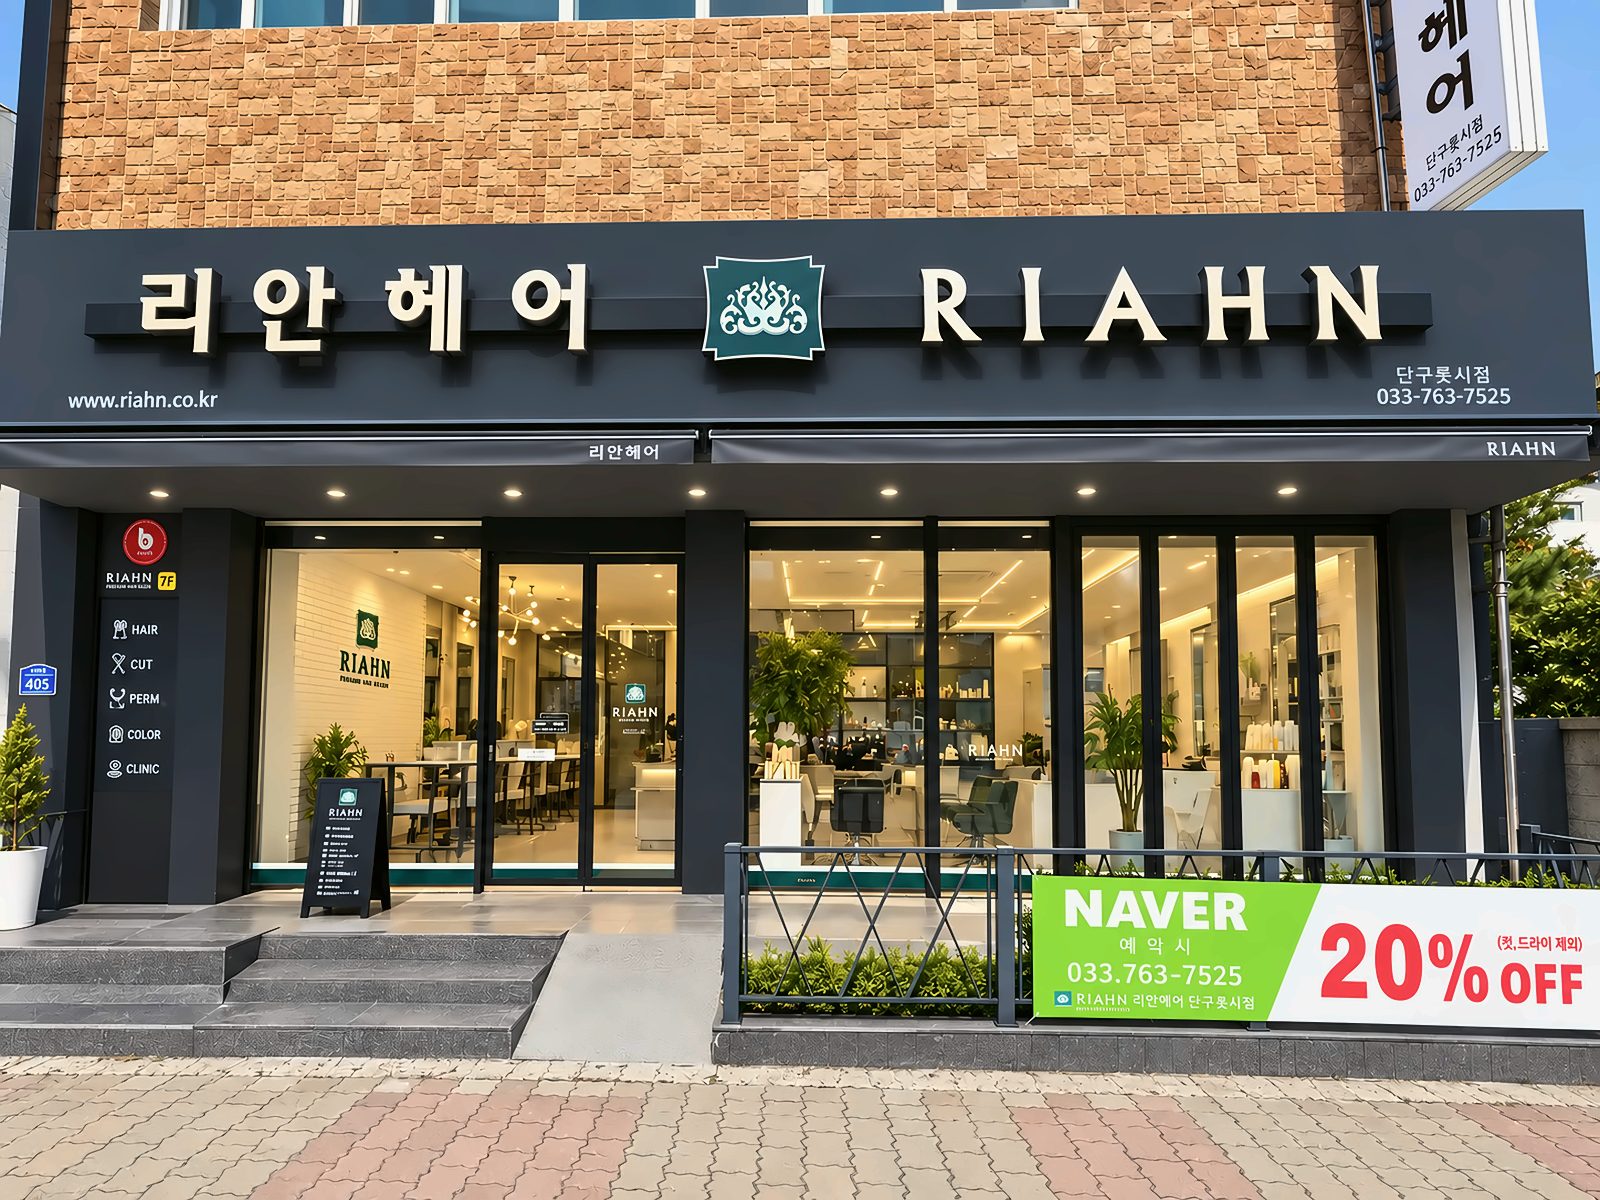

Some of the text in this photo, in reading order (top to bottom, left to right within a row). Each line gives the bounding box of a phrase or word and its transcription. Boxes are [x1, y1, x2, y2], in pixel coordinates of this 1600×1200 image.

[1414, 125, 1502, 202] 033-763-7525
[140, 263, 588, 355] 리안헤어
[920, 265, 1382, 345] RIAHN
[1396, 366, 1490, 384] 단구롯시점
[68, 390, 219, 408] www.riahn.co.kr
[1377, 388, 1511, 405] 033-763-7525
[589, 444, 659, 460] 리안헤어
[1487, 441, 1556, 456] RIAHN
[106, 572, 152, 583] RIAHN
[160, 576, 174, 587] 7F
[131, 624, 158, 635] HAIR
[130, 659, 153, 670] CUT
[339, 649, 391, 679] RIAHN
[25, 678, 49, 690] 405
[129, 693, 160, 704] PERM
[612, 707, 658, 718] RIAHN
[127, 729, 161, 740] COLOR
[968, 744, 1023, 757] RIAHN
[126, 764, 160, 774] CLINIC
[328, 808, 363, 817] RIAHN
[1064, 889, 1248, 931] NAVER
[1555, 936, 1582, 952] 제외)
[1321, 922, 1582, 1004] 20% OFF
[1067, 962, 1242, 986] 033.763-7525
[1076, 993, 1127, 1005] RIAHN
